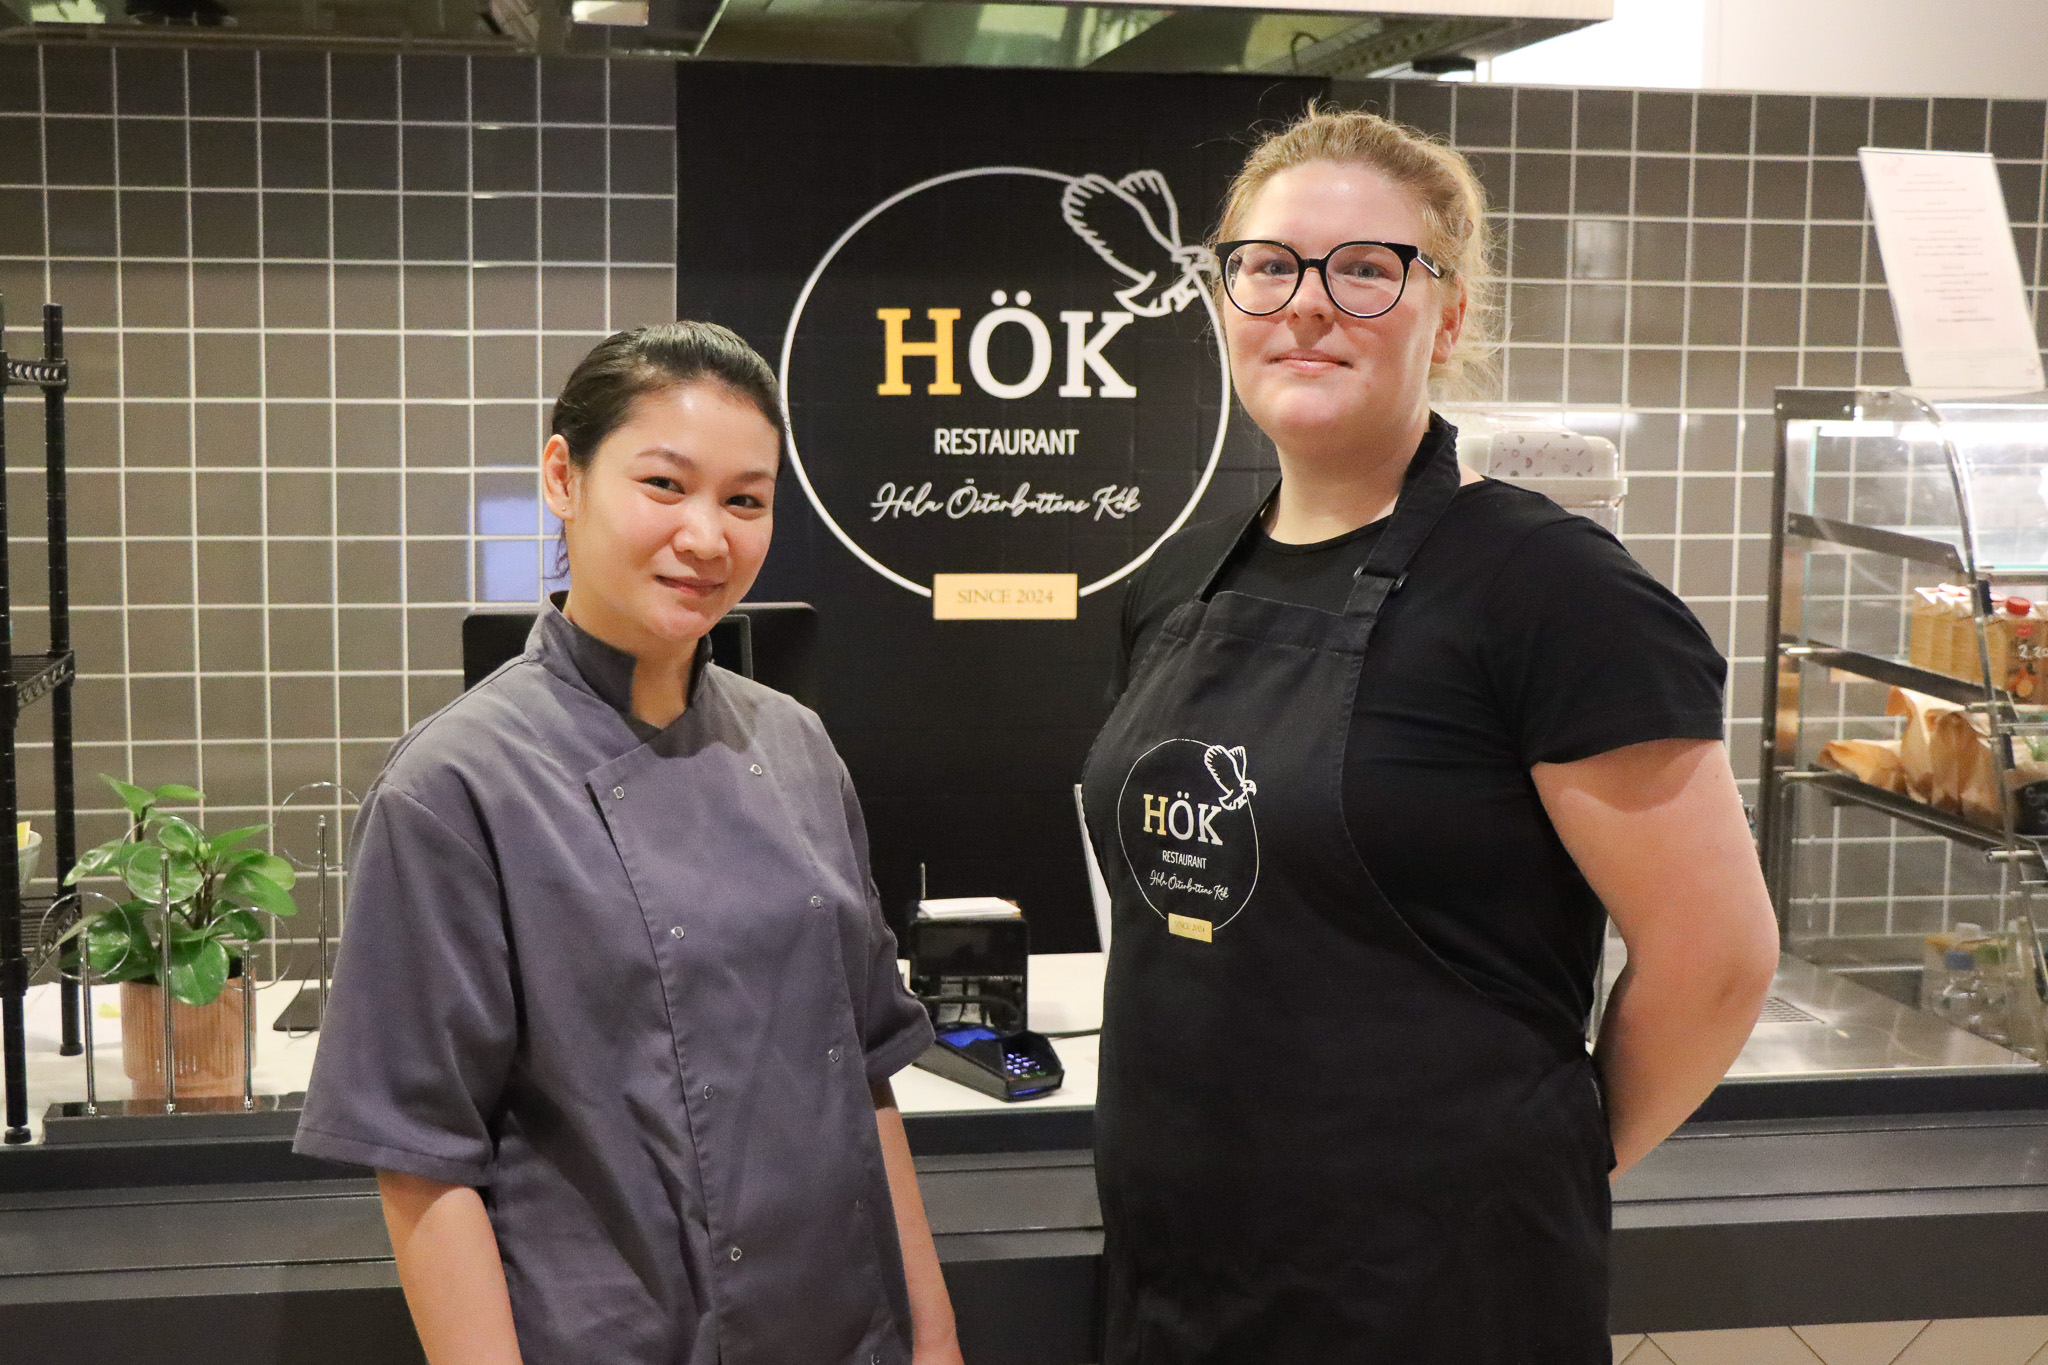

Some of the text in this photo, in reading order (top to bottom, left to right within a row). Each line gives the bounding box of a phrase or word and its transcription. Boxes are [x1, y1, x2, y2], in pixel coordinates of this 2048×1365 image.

[877, 289, 1137, 399] HÖK
[934, 428, 1080, 456] RESTAURANT
[946, 478, 1090, 519] Österbottens
[957, 589, 1055, 604] SINCE 2024
[1143, 791, 1223, 845] HÖK
[1162, 849, 1207, 870] RESTAURANT
